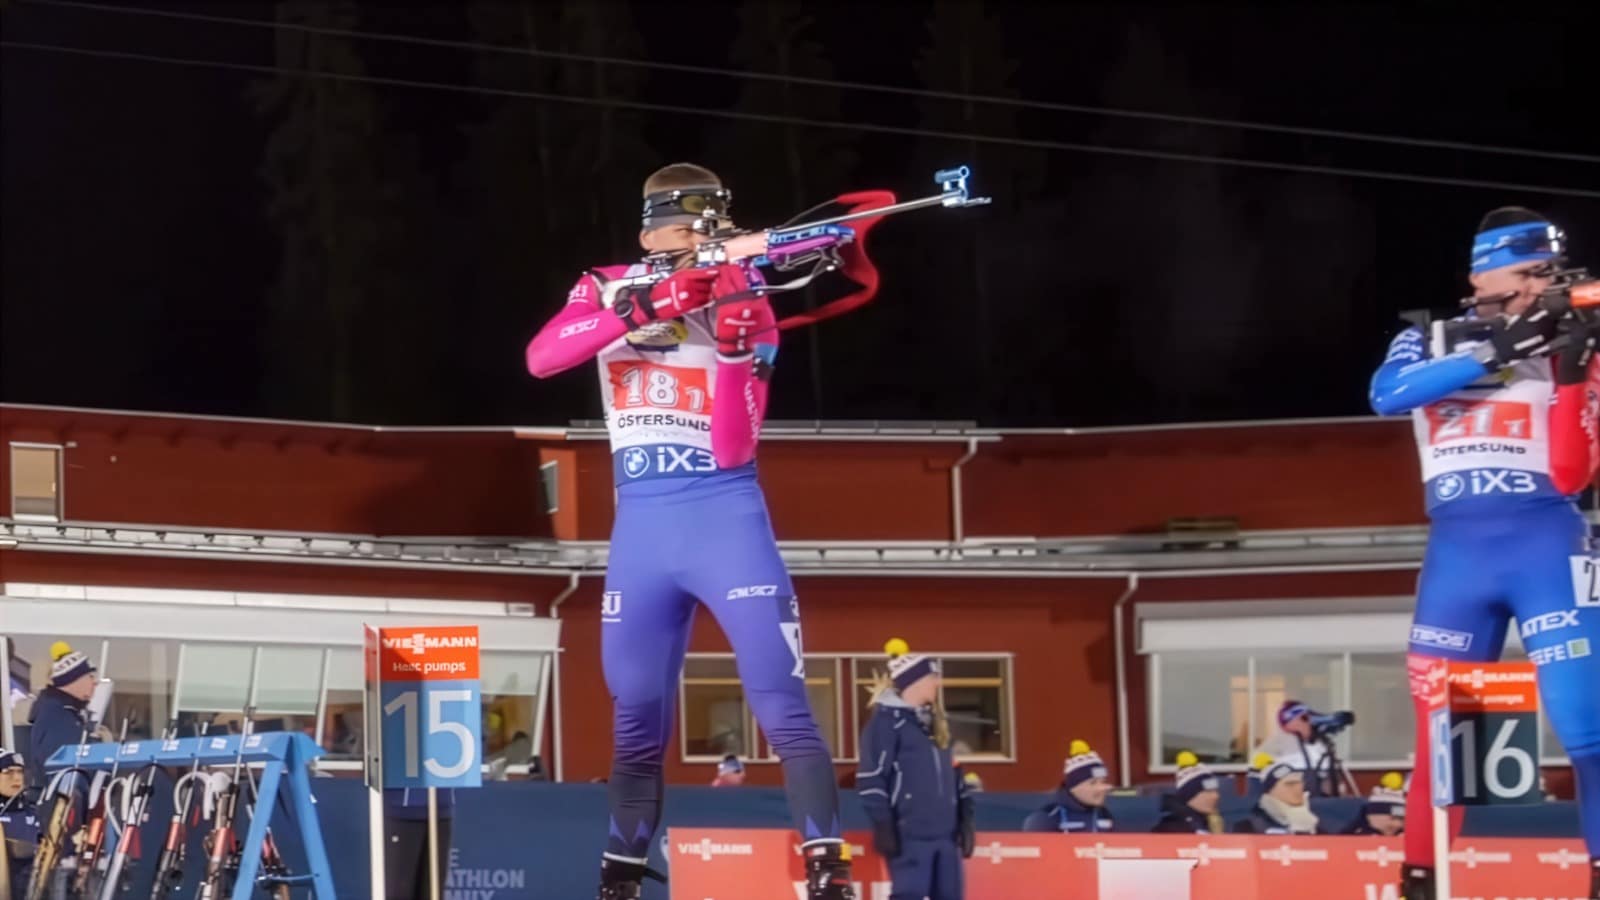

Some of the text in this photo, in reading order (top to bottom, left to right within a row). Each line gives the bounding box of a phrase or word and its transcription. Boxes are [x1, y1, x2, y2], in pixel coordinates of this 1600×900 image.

[621, 367, 678, 408] 18
[656, 446, 717, 473] iX3
[1470, 469, 1537, 494] iX3
[382, 633, 477, 655] VIESSMANN
[424, 662, 466, 674] pumps
[384, 690, 476, 779] 15
[1450, 718, 1536, 799] 16
[444, 868, 525, 889] ATHLON
